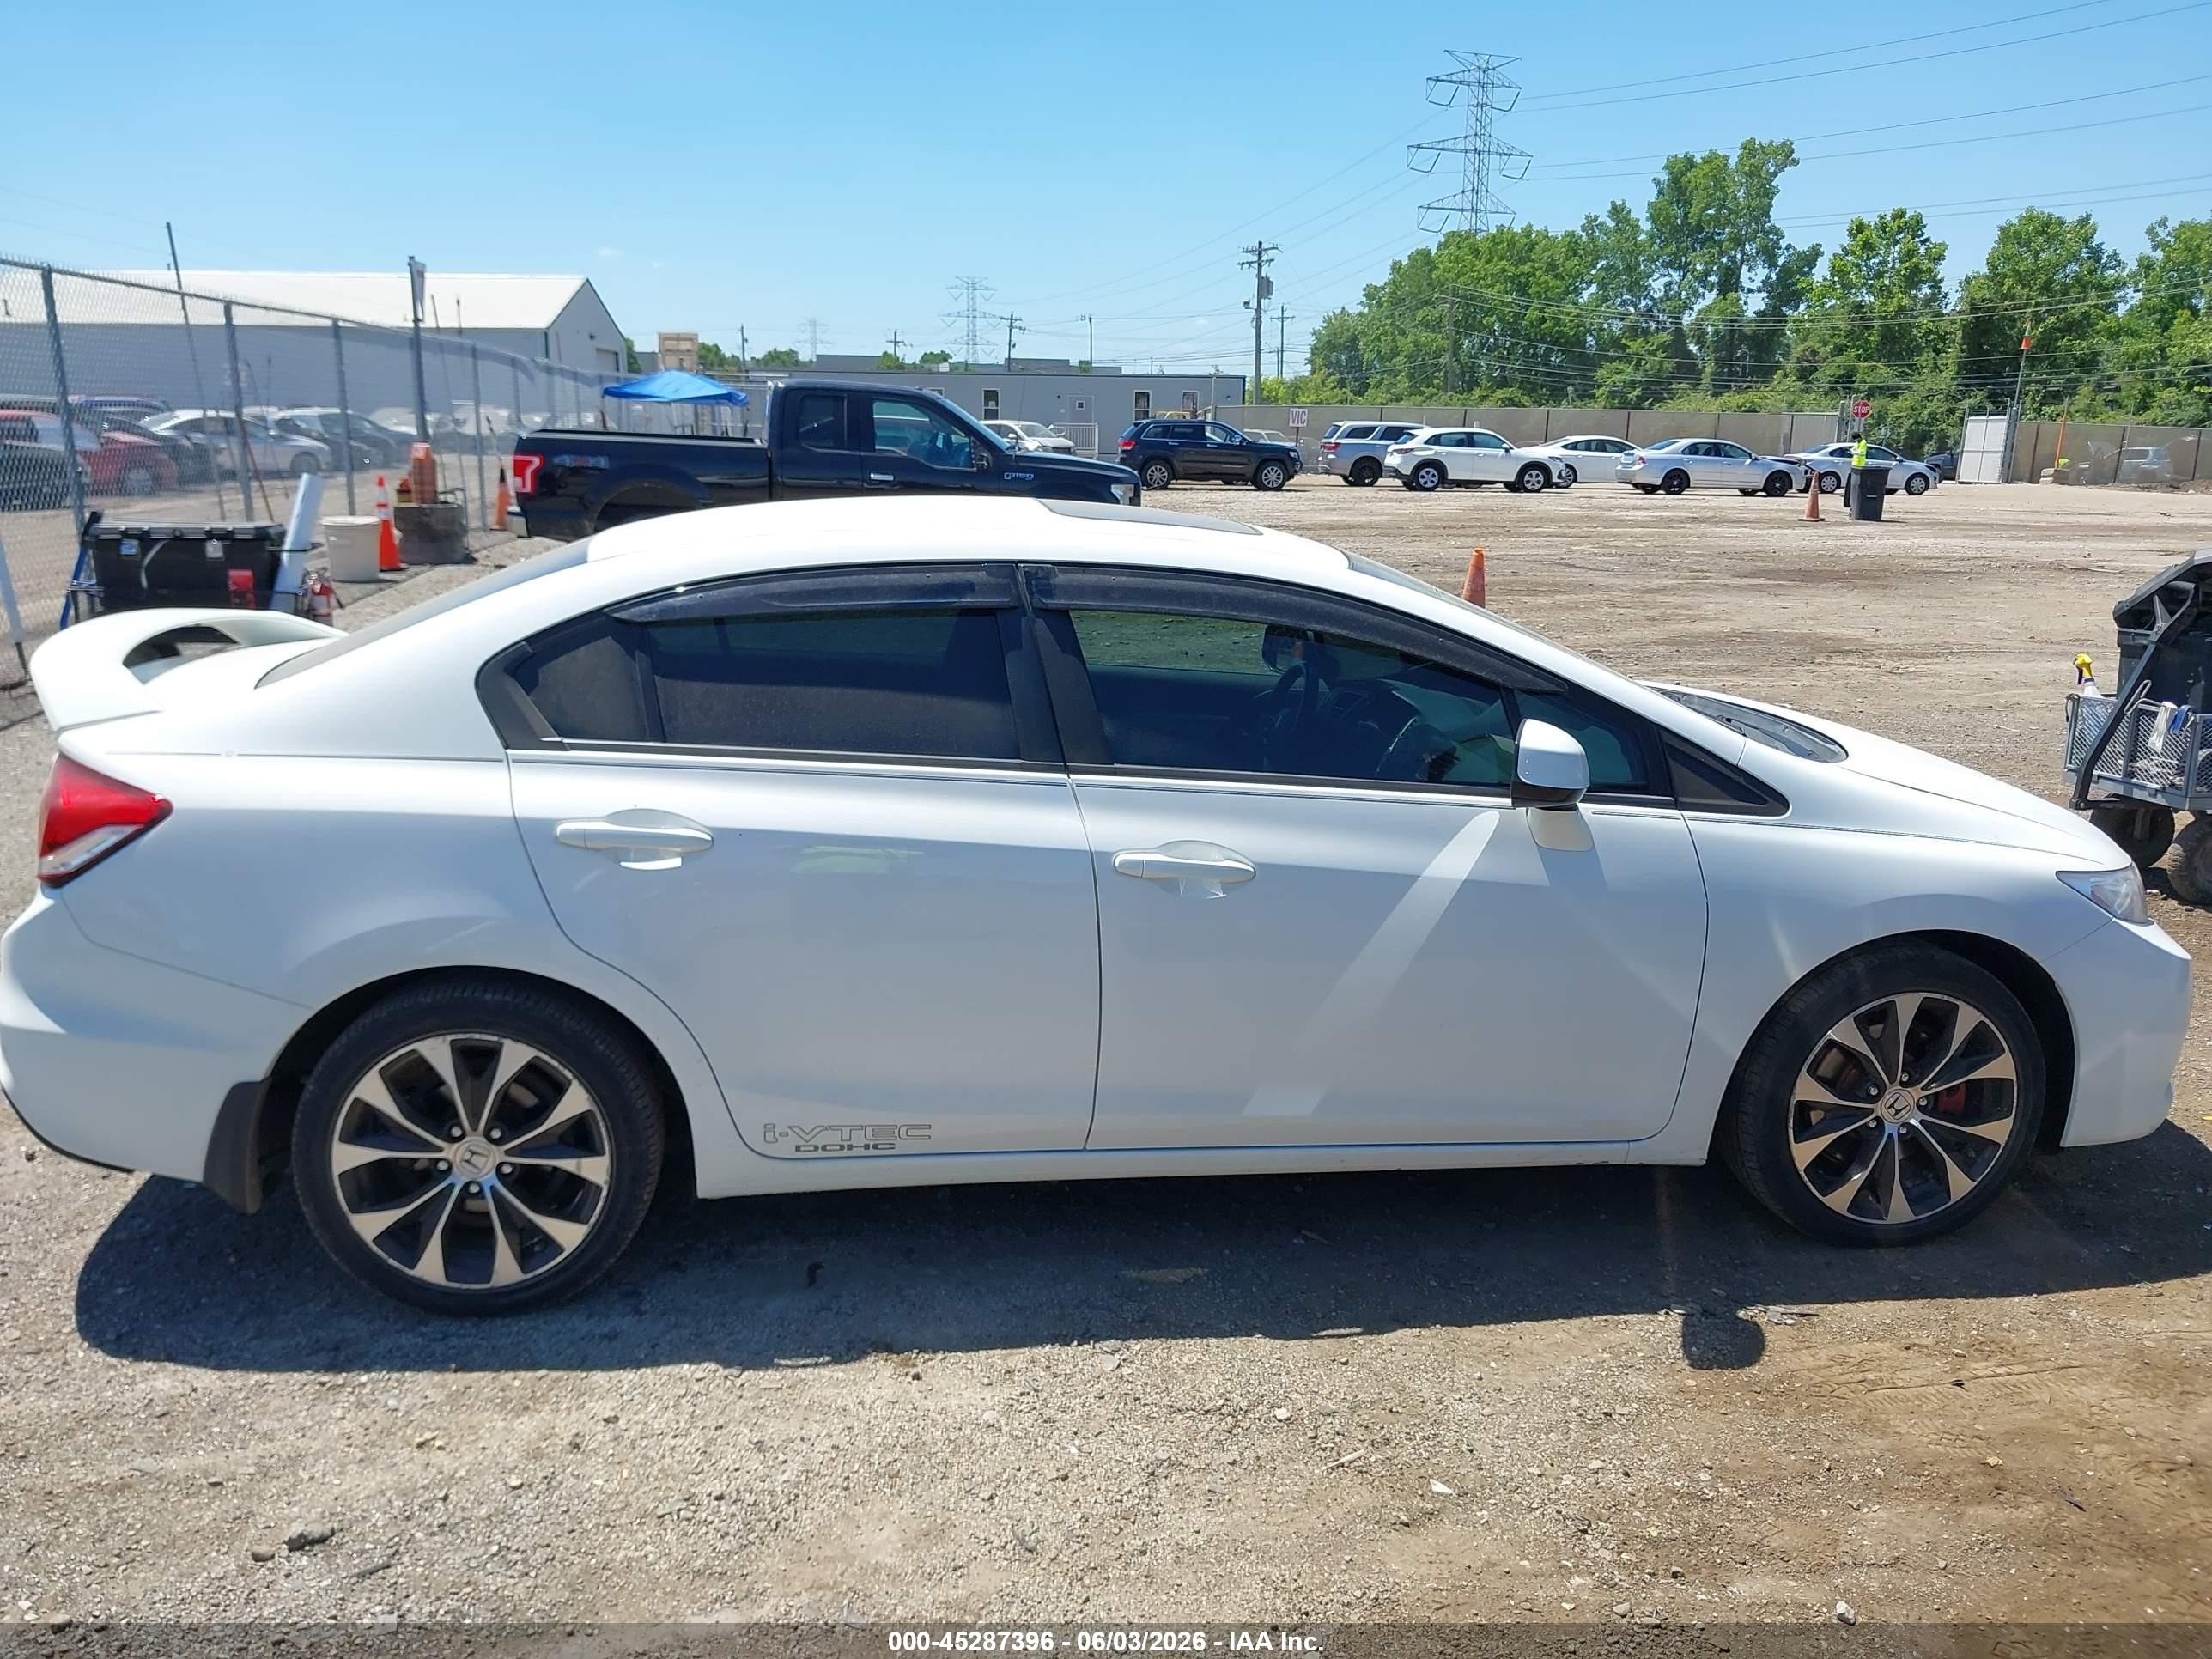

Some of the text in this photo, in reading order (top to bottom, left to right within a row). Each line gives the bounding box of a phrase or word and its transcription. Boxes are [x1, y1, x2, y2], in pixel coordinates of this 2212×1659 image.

[1853, 405, 1870, 414] STOP
[1291, 410, 1307, 425] VIC
[763, 1122, 932, 1144] i-VTEC
[794, 1142, 897, 1152] DOHC
